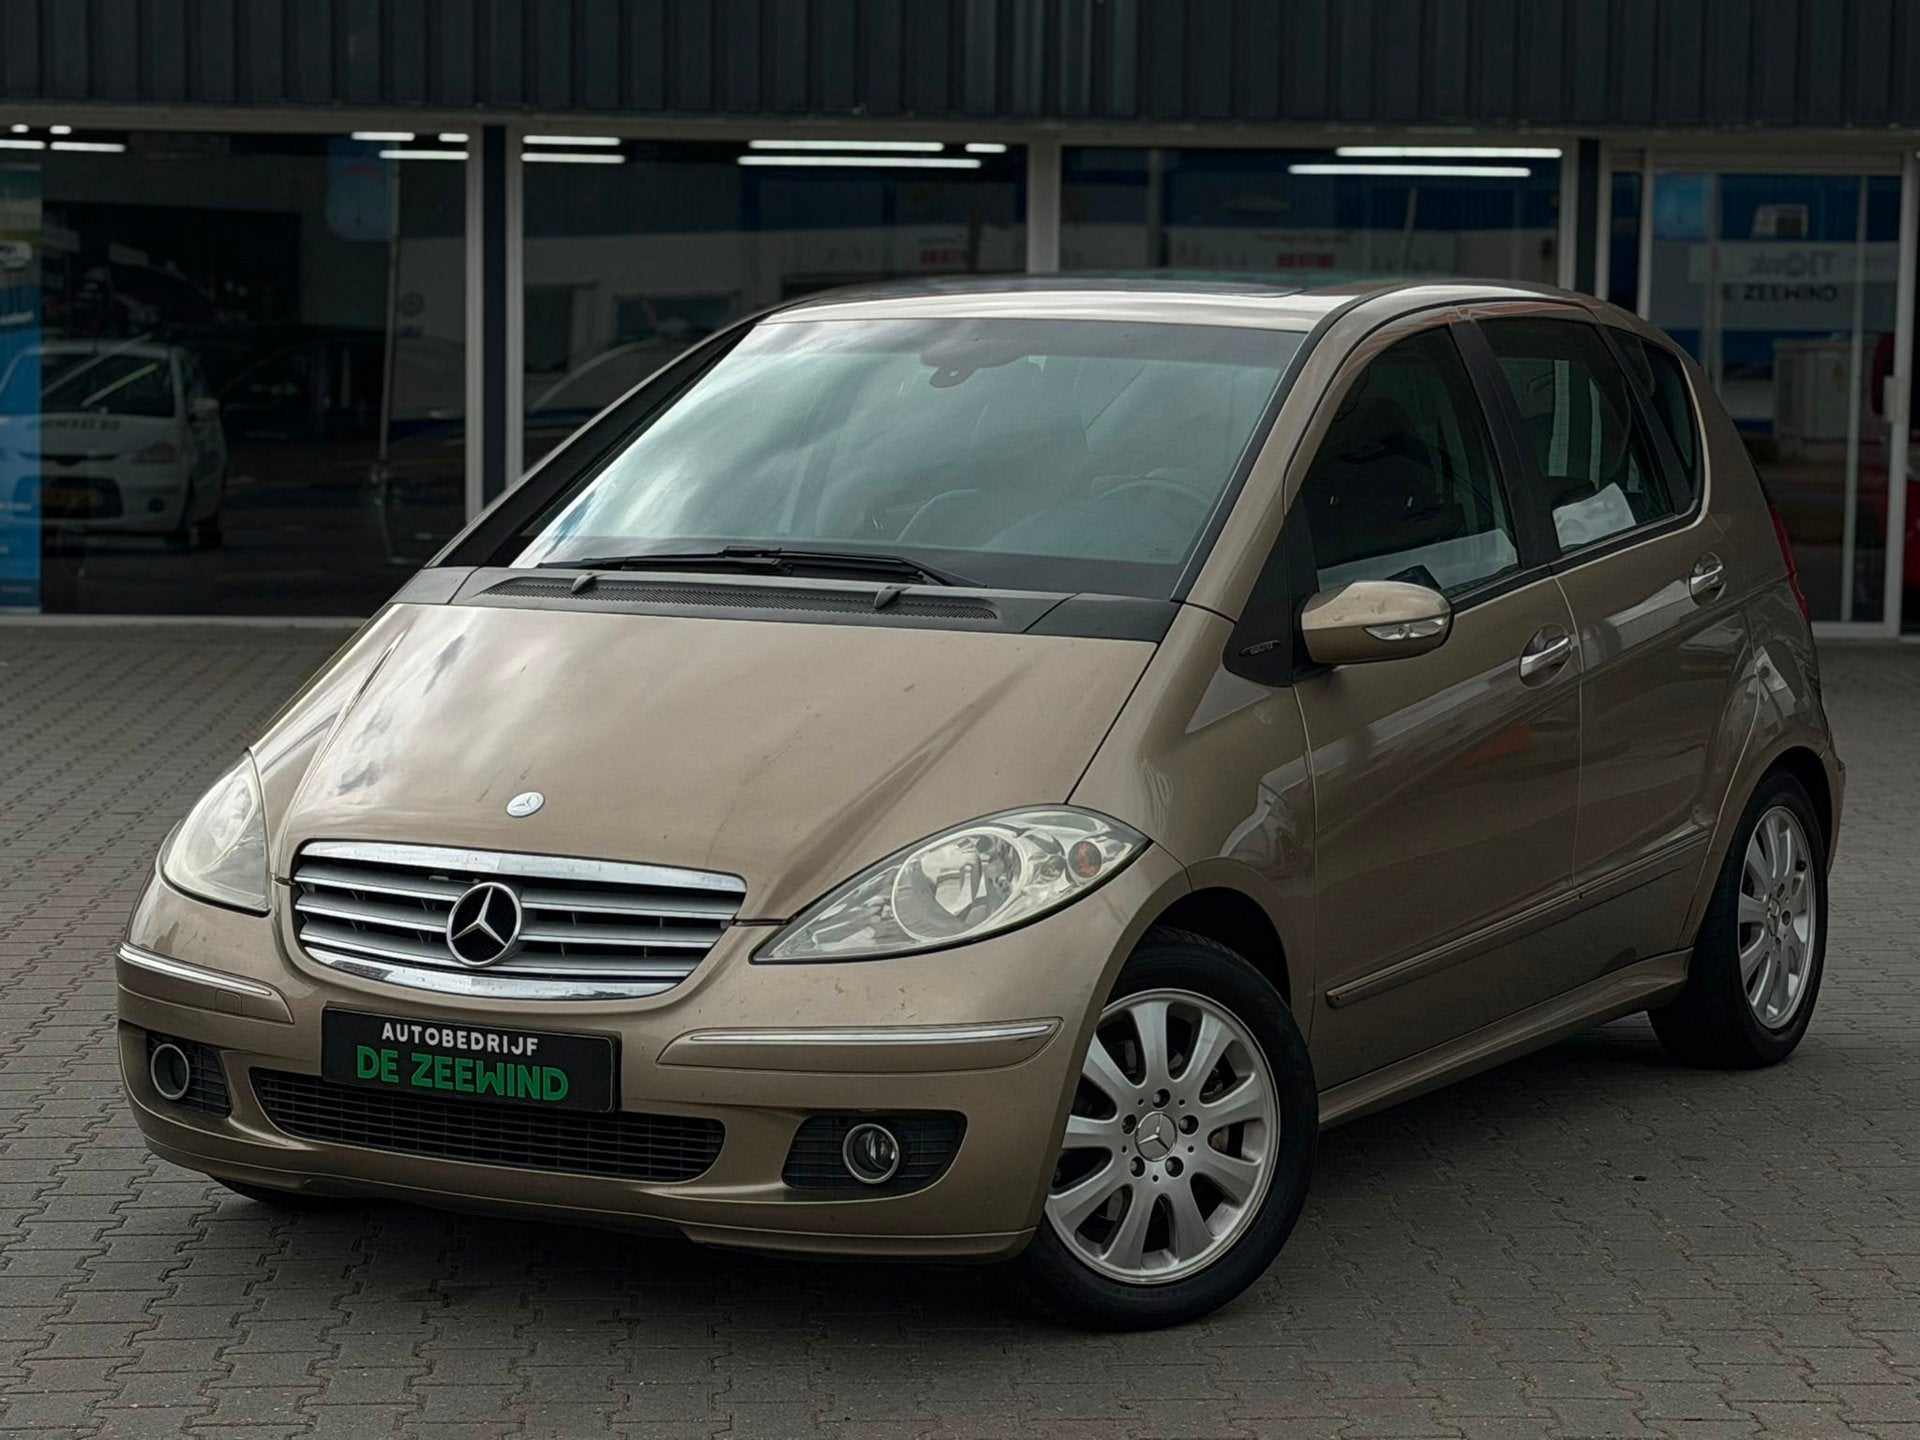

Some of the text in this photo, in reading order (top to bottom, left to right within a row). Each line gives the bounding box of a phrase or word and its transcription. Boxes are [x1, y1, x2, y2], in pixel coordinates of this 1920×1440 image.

[382, 1022, 538, 1055] AUTOBEDRIJF
[357, 1045, 569, 1101] DE ZEEWIND
